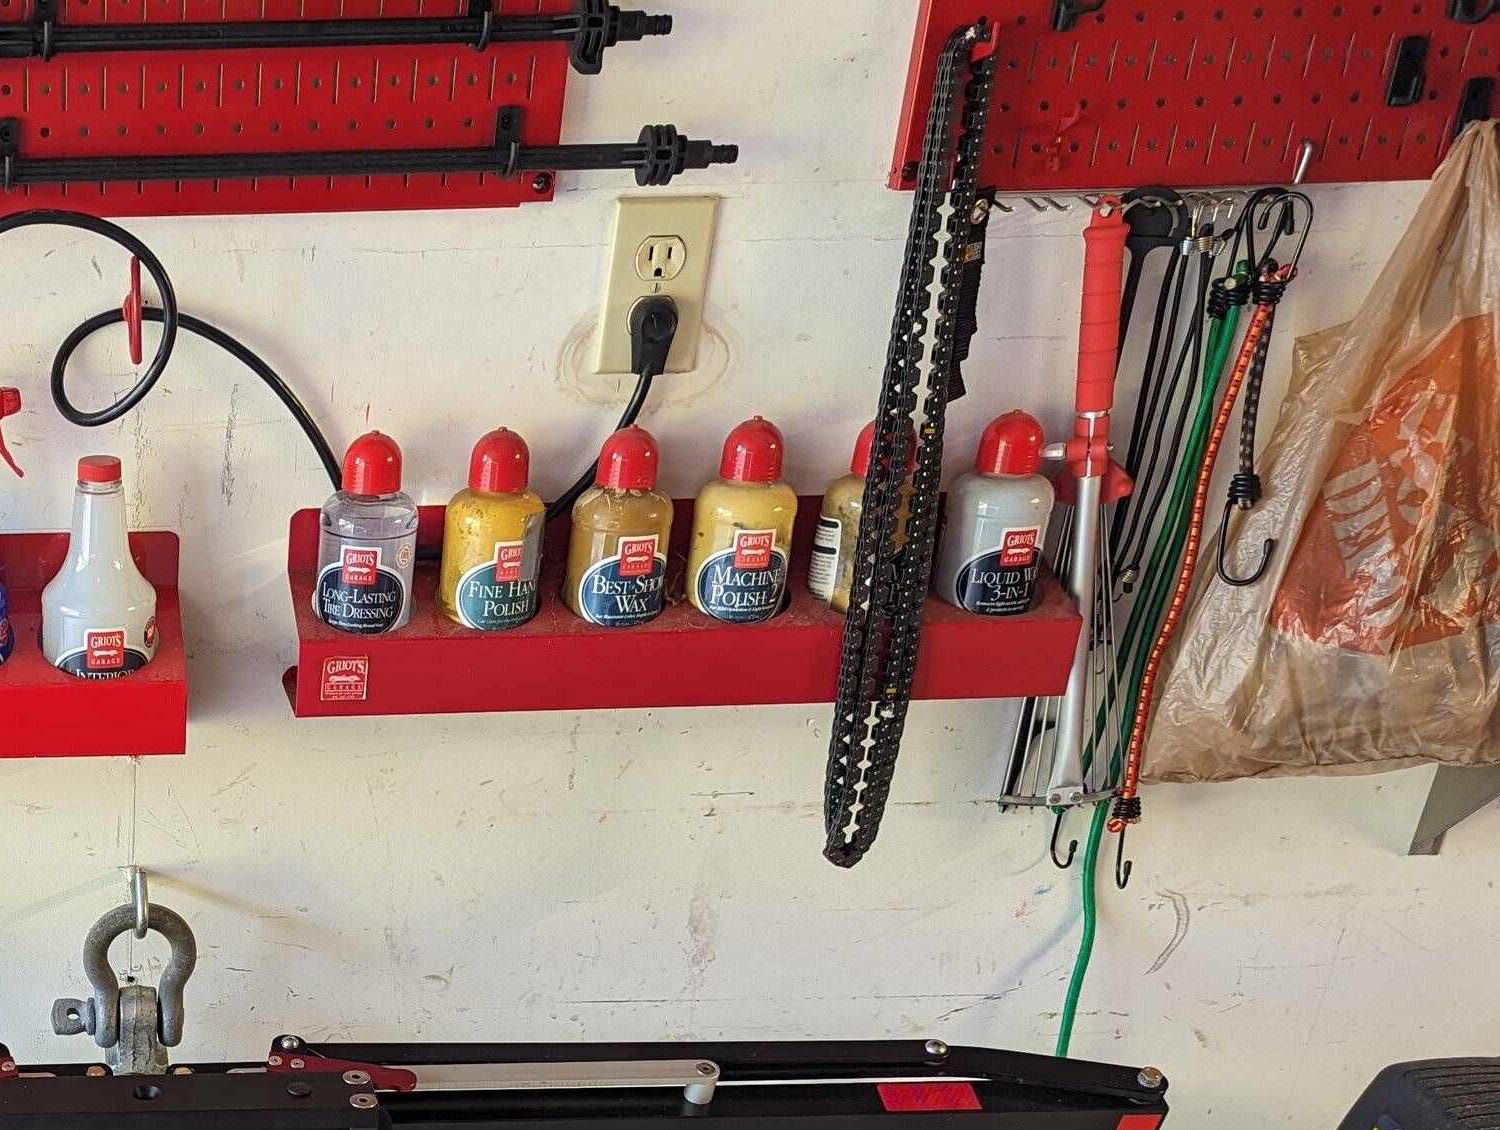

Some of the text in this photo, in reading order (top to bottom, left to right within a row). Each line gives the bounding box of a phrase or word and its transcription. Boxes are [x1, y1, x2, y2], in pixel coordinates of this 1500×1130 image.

[625, 542, 653, 555] GRIOT'S
[740, 535, 770, 547] GRIOT'S
[346, 552, 375, 566] GRIOT'S
[501, 547, 522, 560] GRIO
[592, 574, 631, 594] BEST
[712, 564, 780, 587] MACHINE
[970, 568, 1020, 588] LIQUID
[322, 581, 396, 604] LONG-LASTING
[468, 579, 536, 599] FINE HAN
[709, 584, 767, 607] POLISH
[990, 582, 1029, 601] 3-IN-1
[322, 597, 394, 619] TIRE DRESSING
[483, 599, 529, 617] POLISH
[615, 595, 648, 613] WAX
[91, 633, 121, 648] GRIOT'S
[327, 659, 365, 674] GRIOT'S
